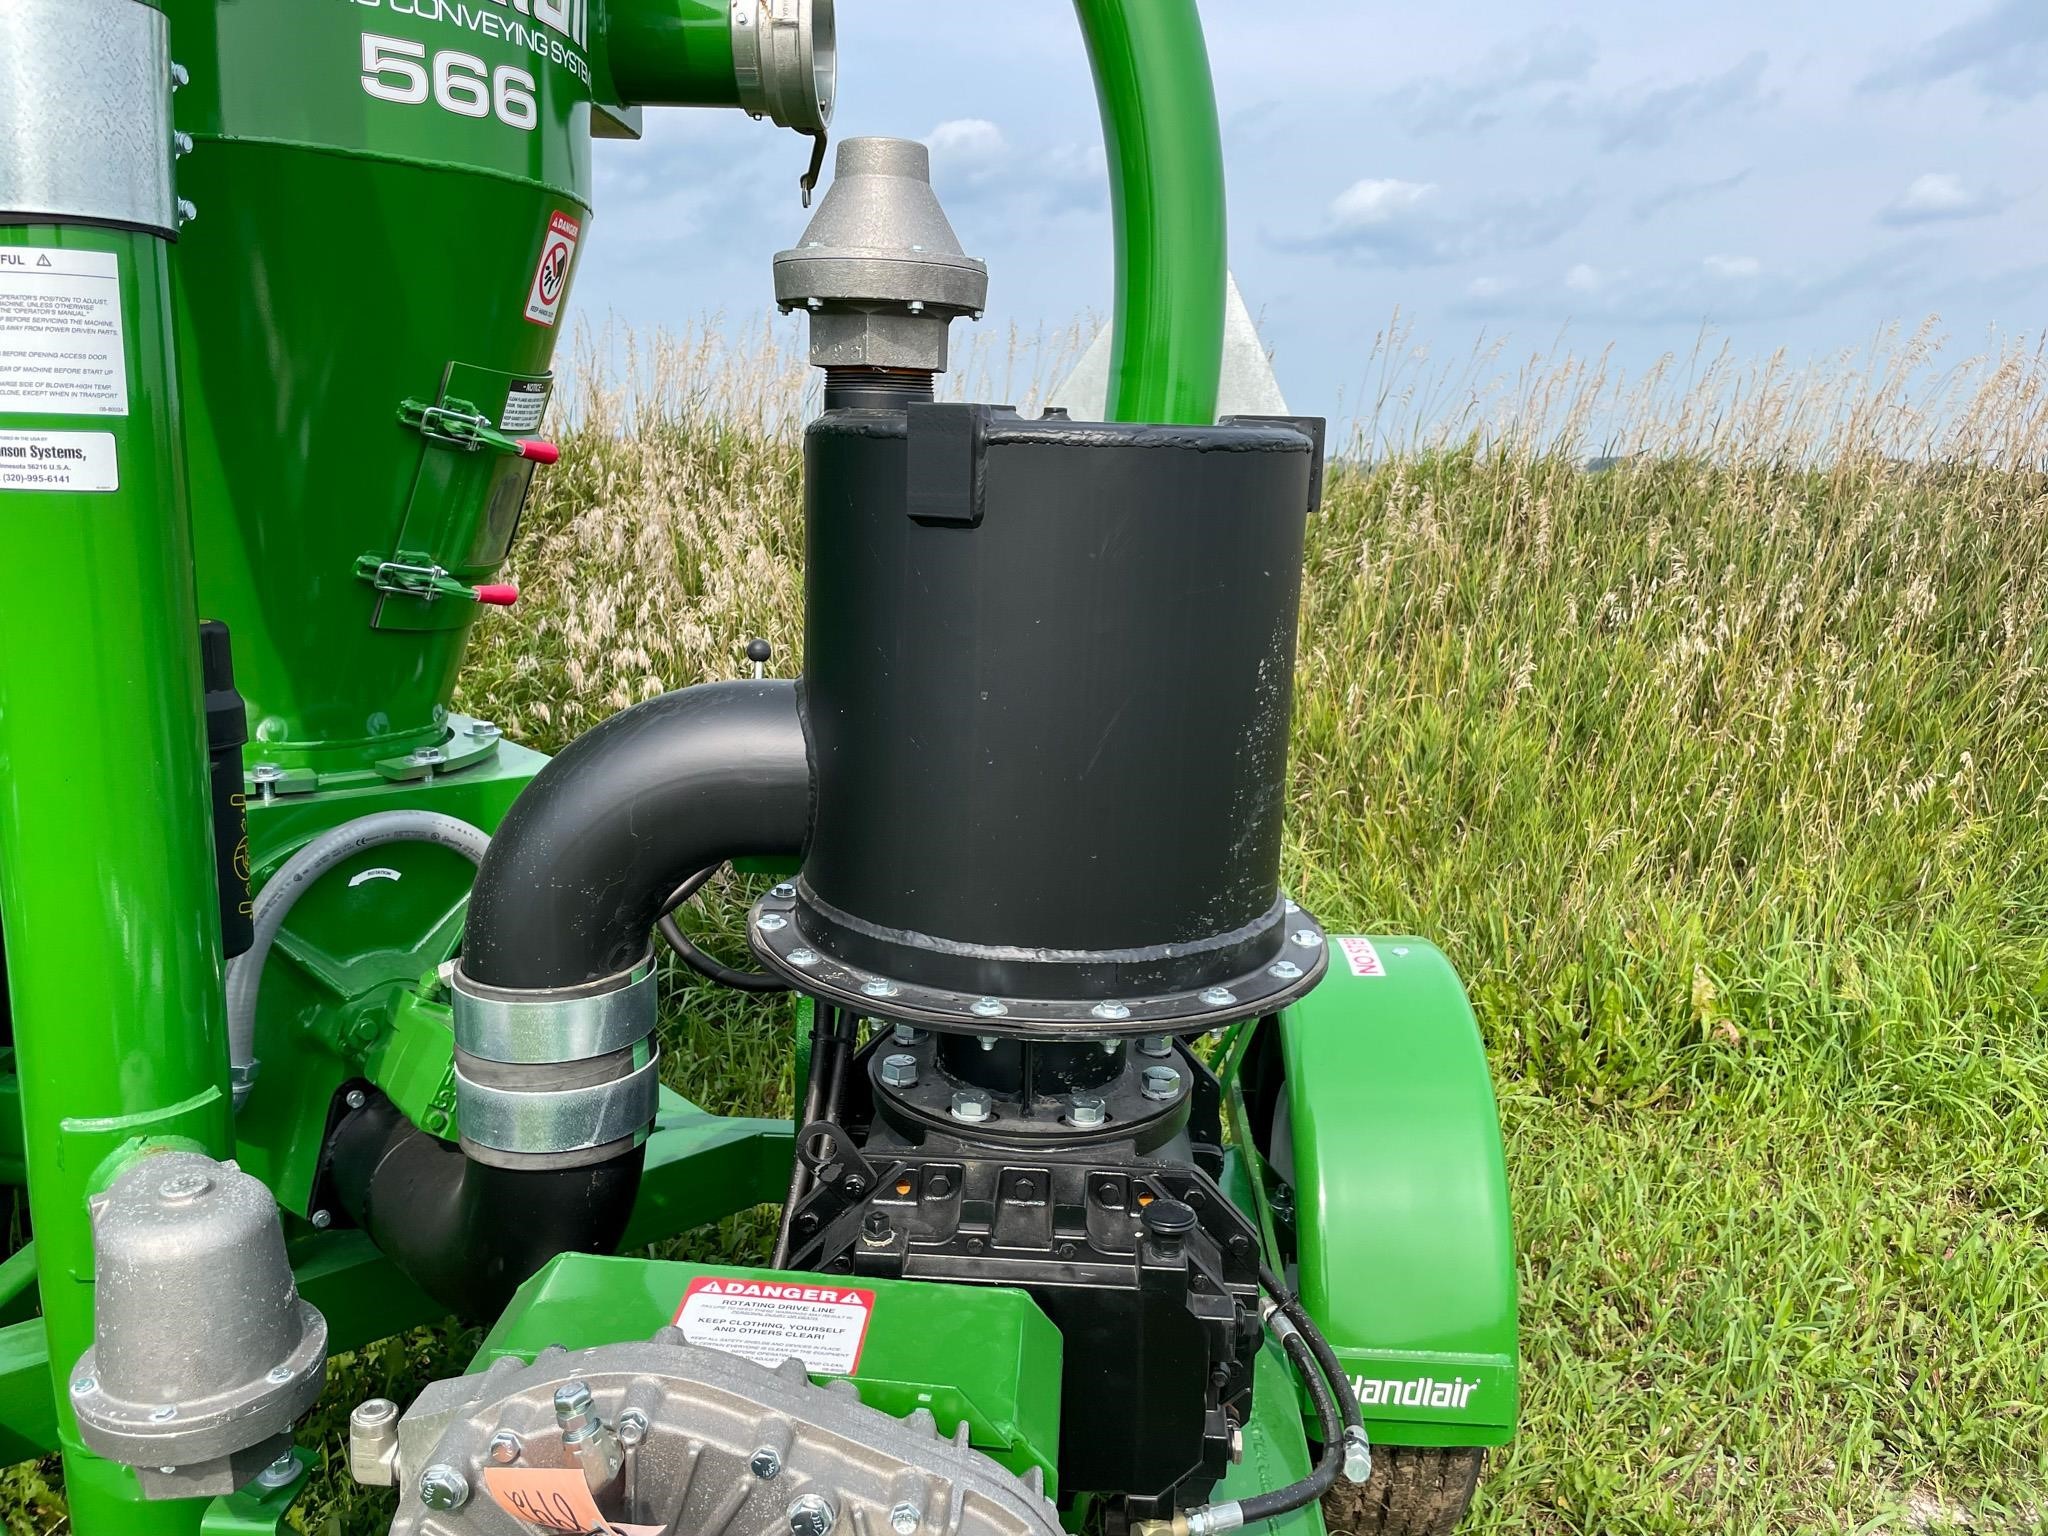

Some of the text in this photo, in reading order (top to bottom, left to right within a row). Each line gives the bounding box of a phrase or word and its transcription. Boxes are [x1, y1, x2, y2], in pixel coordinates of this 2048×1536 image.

[390, 0, 548, 56] CONVEYING
[361, 33, 537, 130] 566
[32, 317, 68, 325] SERVICING
[0, 444, 87, 461] nson Systems,
[1353, 955, 1379, 974] NO
[725, 1283, 838, 1303] DANGER
[721, 1299, 836, 1314] ROTATING DRIVE LINE
[698, 1317, 846, 1334] KEEP CLOTHING, YOURSELF
[713, 1325, 825, 1340] AND OTHERS CLEAR!
[1346, 1374, 1478, 1408] Handlair
